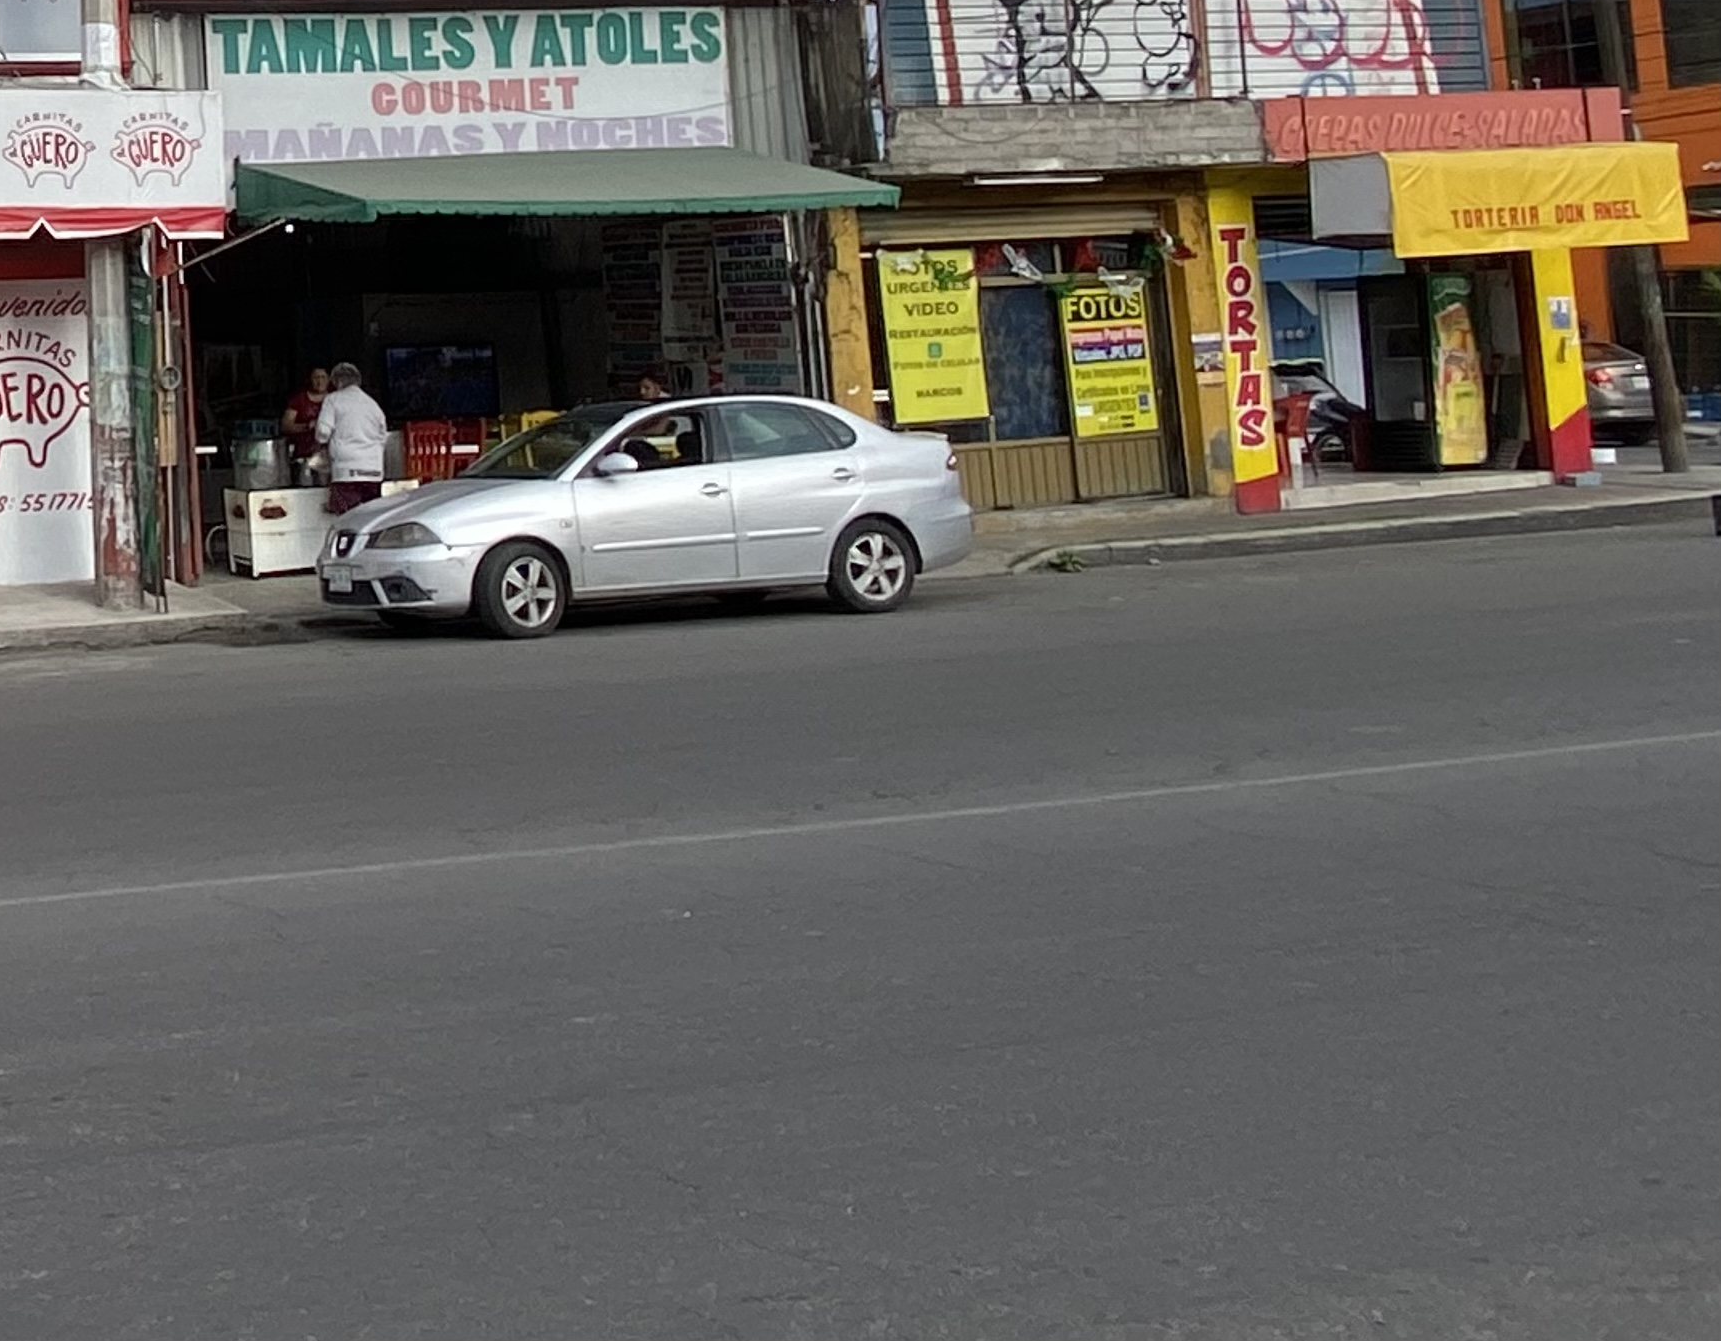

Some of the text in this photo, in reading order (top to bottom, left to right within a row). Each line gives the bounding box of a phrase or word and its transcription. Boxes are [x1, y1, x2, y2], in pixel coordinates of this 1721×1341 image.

[212, 11, 722, 74] TAMALES Y ATOLES
[371, 76, 580, 116] GOURMET
[16, 112, 83, 132] CARNITAS
[123, 112, 189, 131] CARNITAS
[224, 116, 726, 161] MAÑANAS Y NOCHES
[1450, 200, 1642, 228] TORTERIA DON ANGEL
[890, 259, 958, 276] OTOS
[904, 301, 959, 317] VIDEO
[1067, 295, 1140, 320] FOTOS
[1218, 227, 1267, 447] TORTAS
[916, 386, 963, 398] MARCOS
